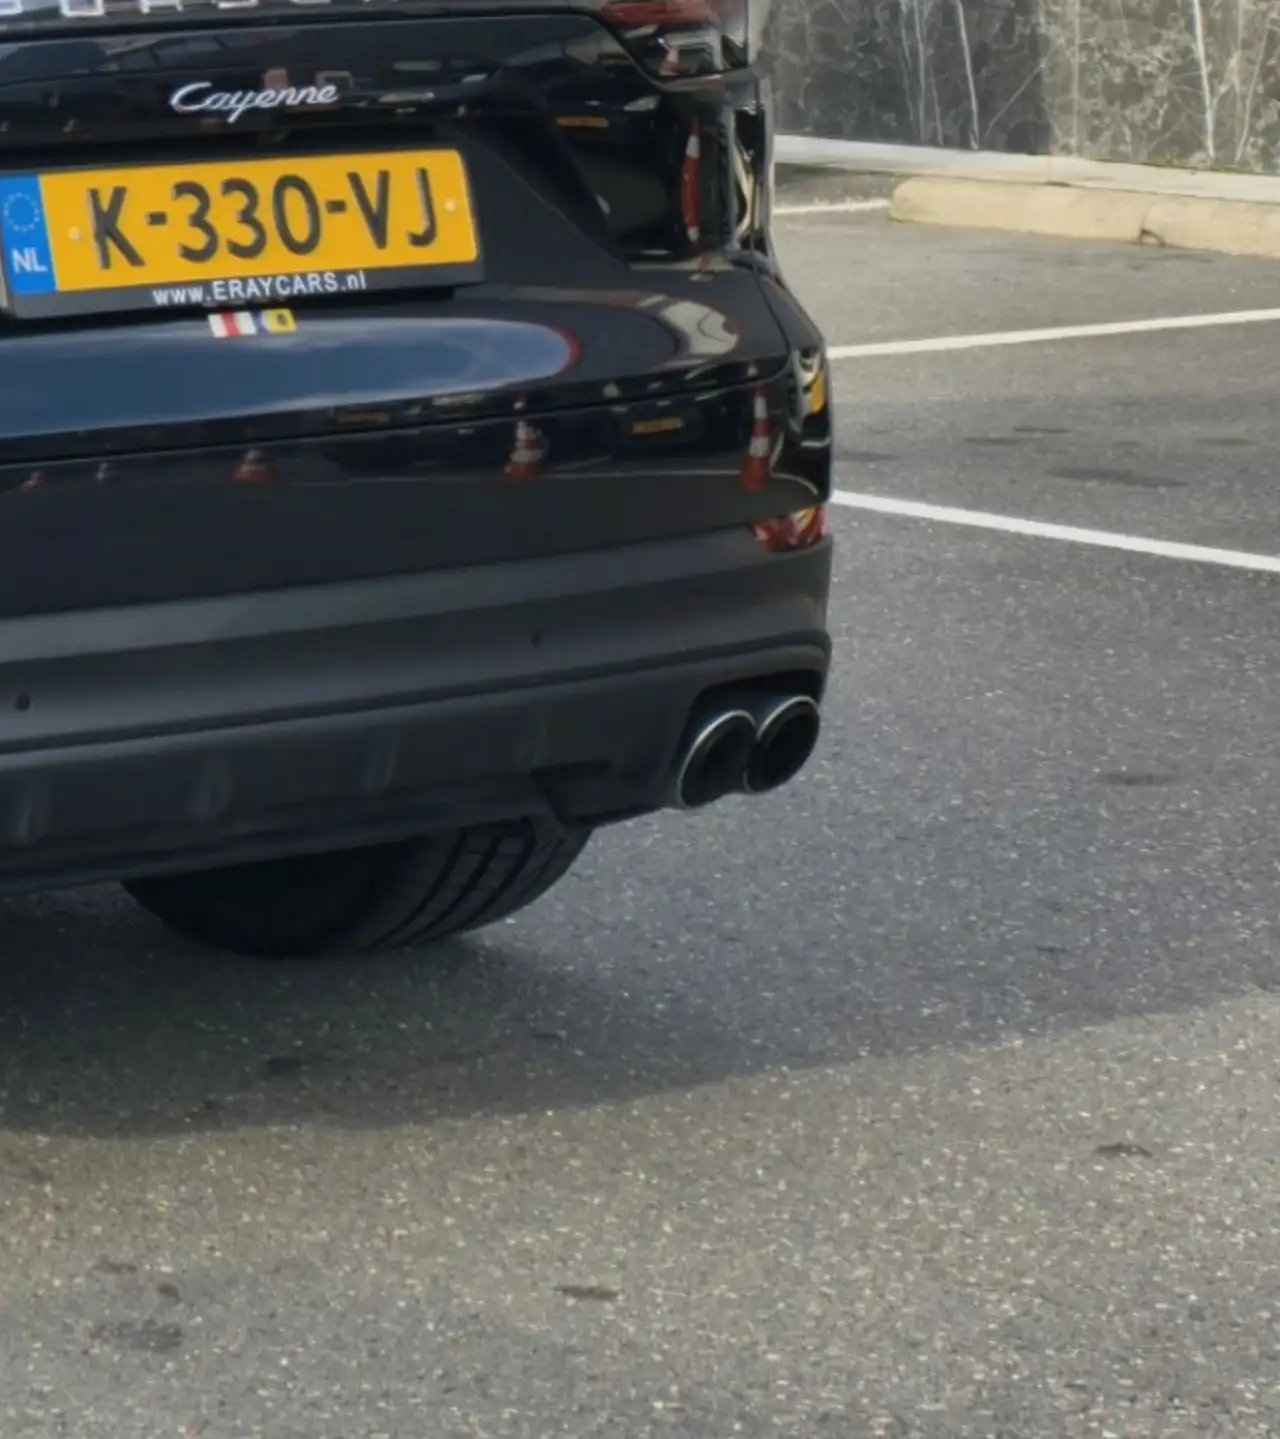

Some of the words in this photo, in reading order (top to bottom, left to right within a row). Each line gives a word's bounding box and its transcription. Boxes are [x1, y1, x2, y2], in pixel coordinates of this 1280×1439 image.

[170, 81, 339, 124] Cayenne
[87, 167, 437, 269] K-330-VJ
[11, 246, 48, 274] NL
[152, 270, 367, 306] www.ERAYCARS.nl
